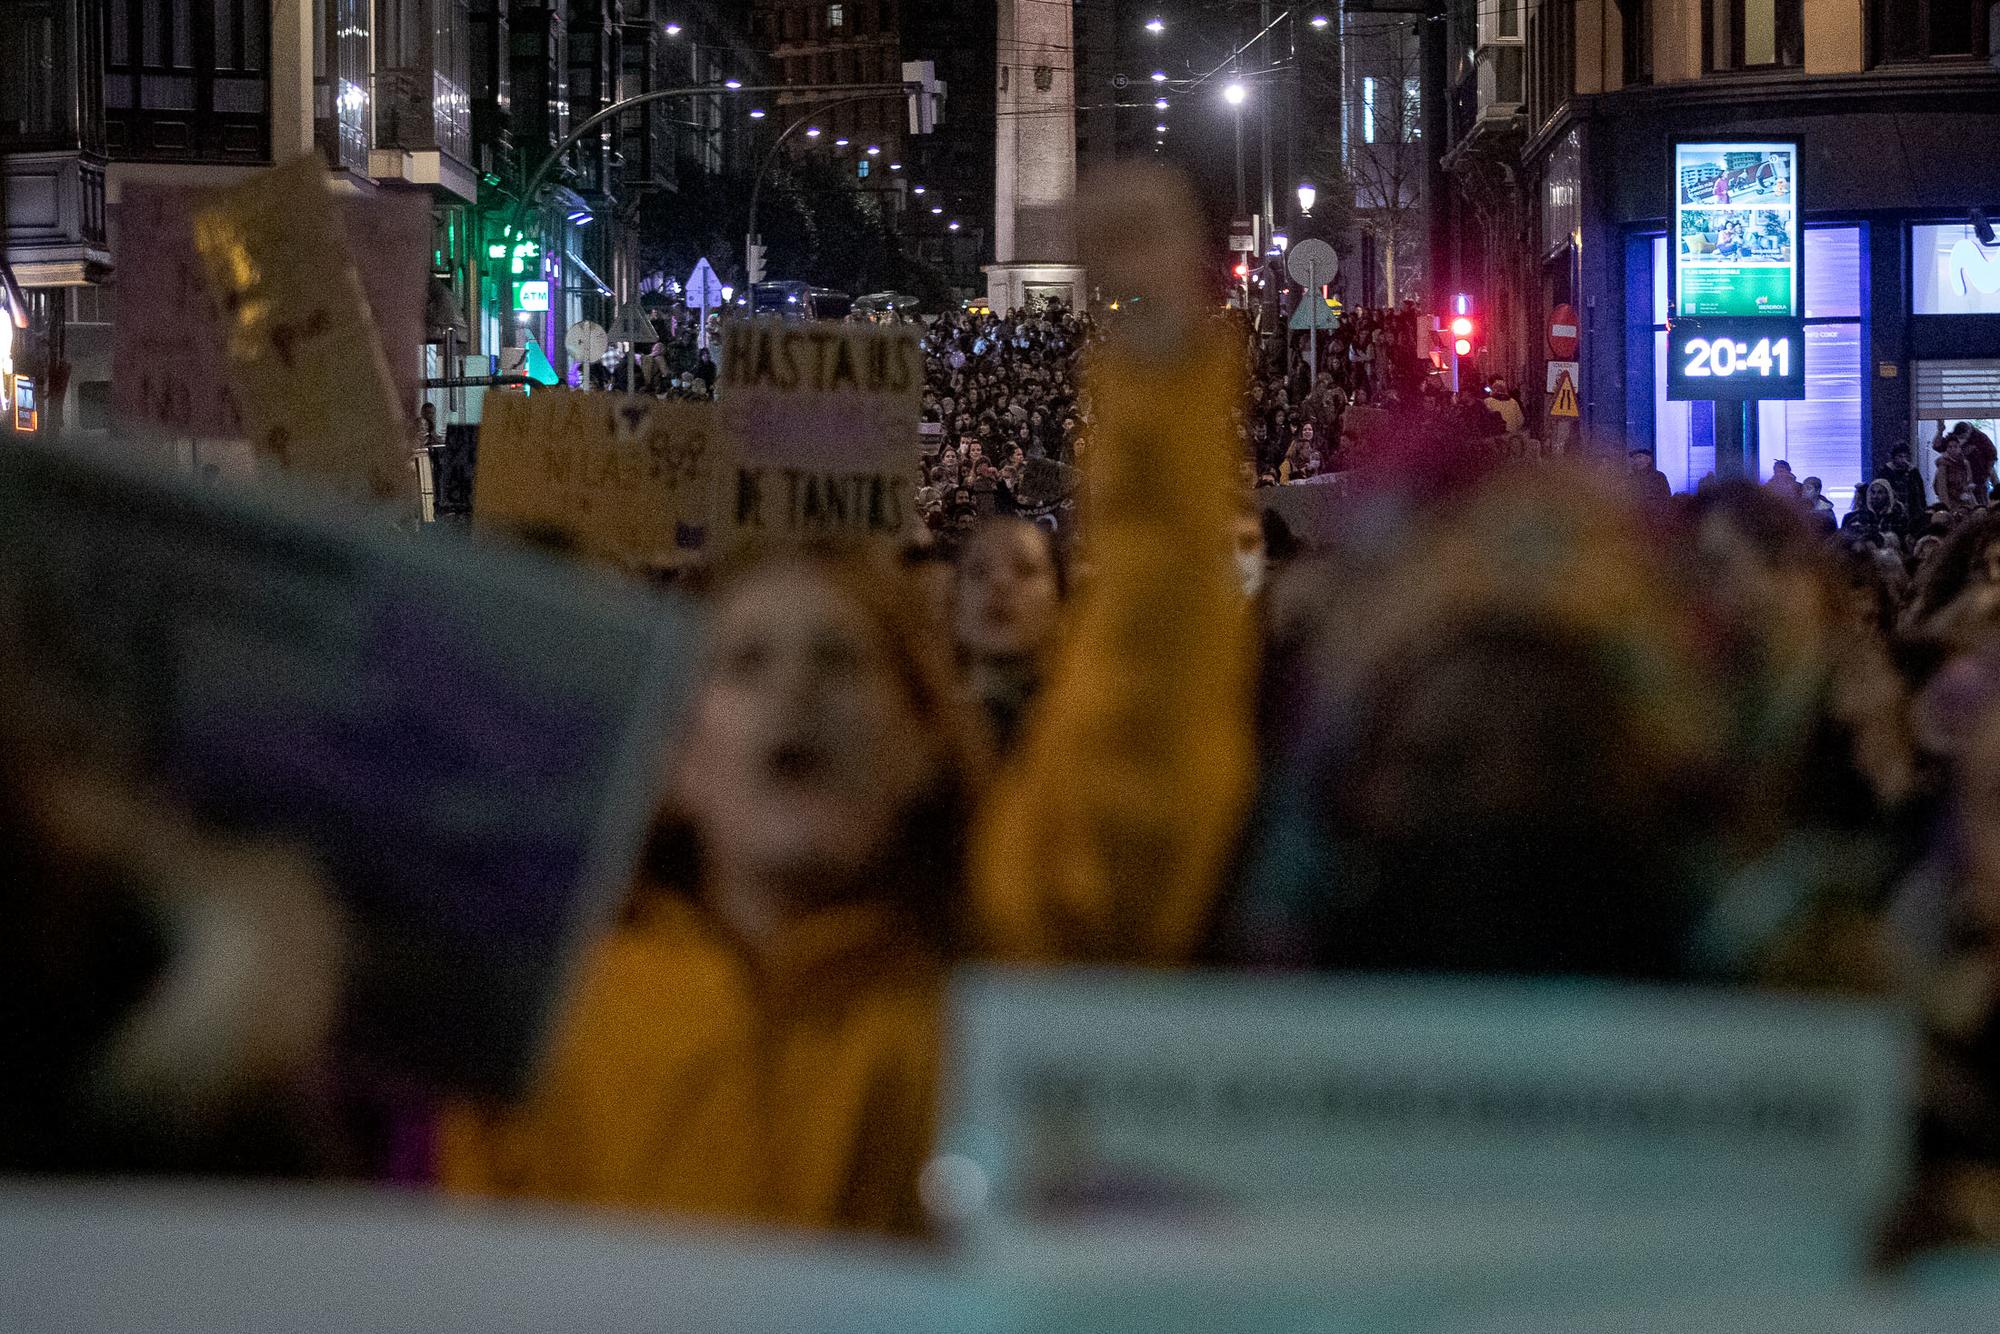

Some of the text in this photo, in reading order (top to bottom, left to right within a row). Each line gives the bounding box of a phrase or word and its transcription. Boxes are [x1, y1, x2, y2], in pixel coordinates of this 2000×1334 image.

[523, 292, 547, 301] ATM
[726, 325, 858, 391] HASTA
[1684, 338, 1789, 377] 20:41
